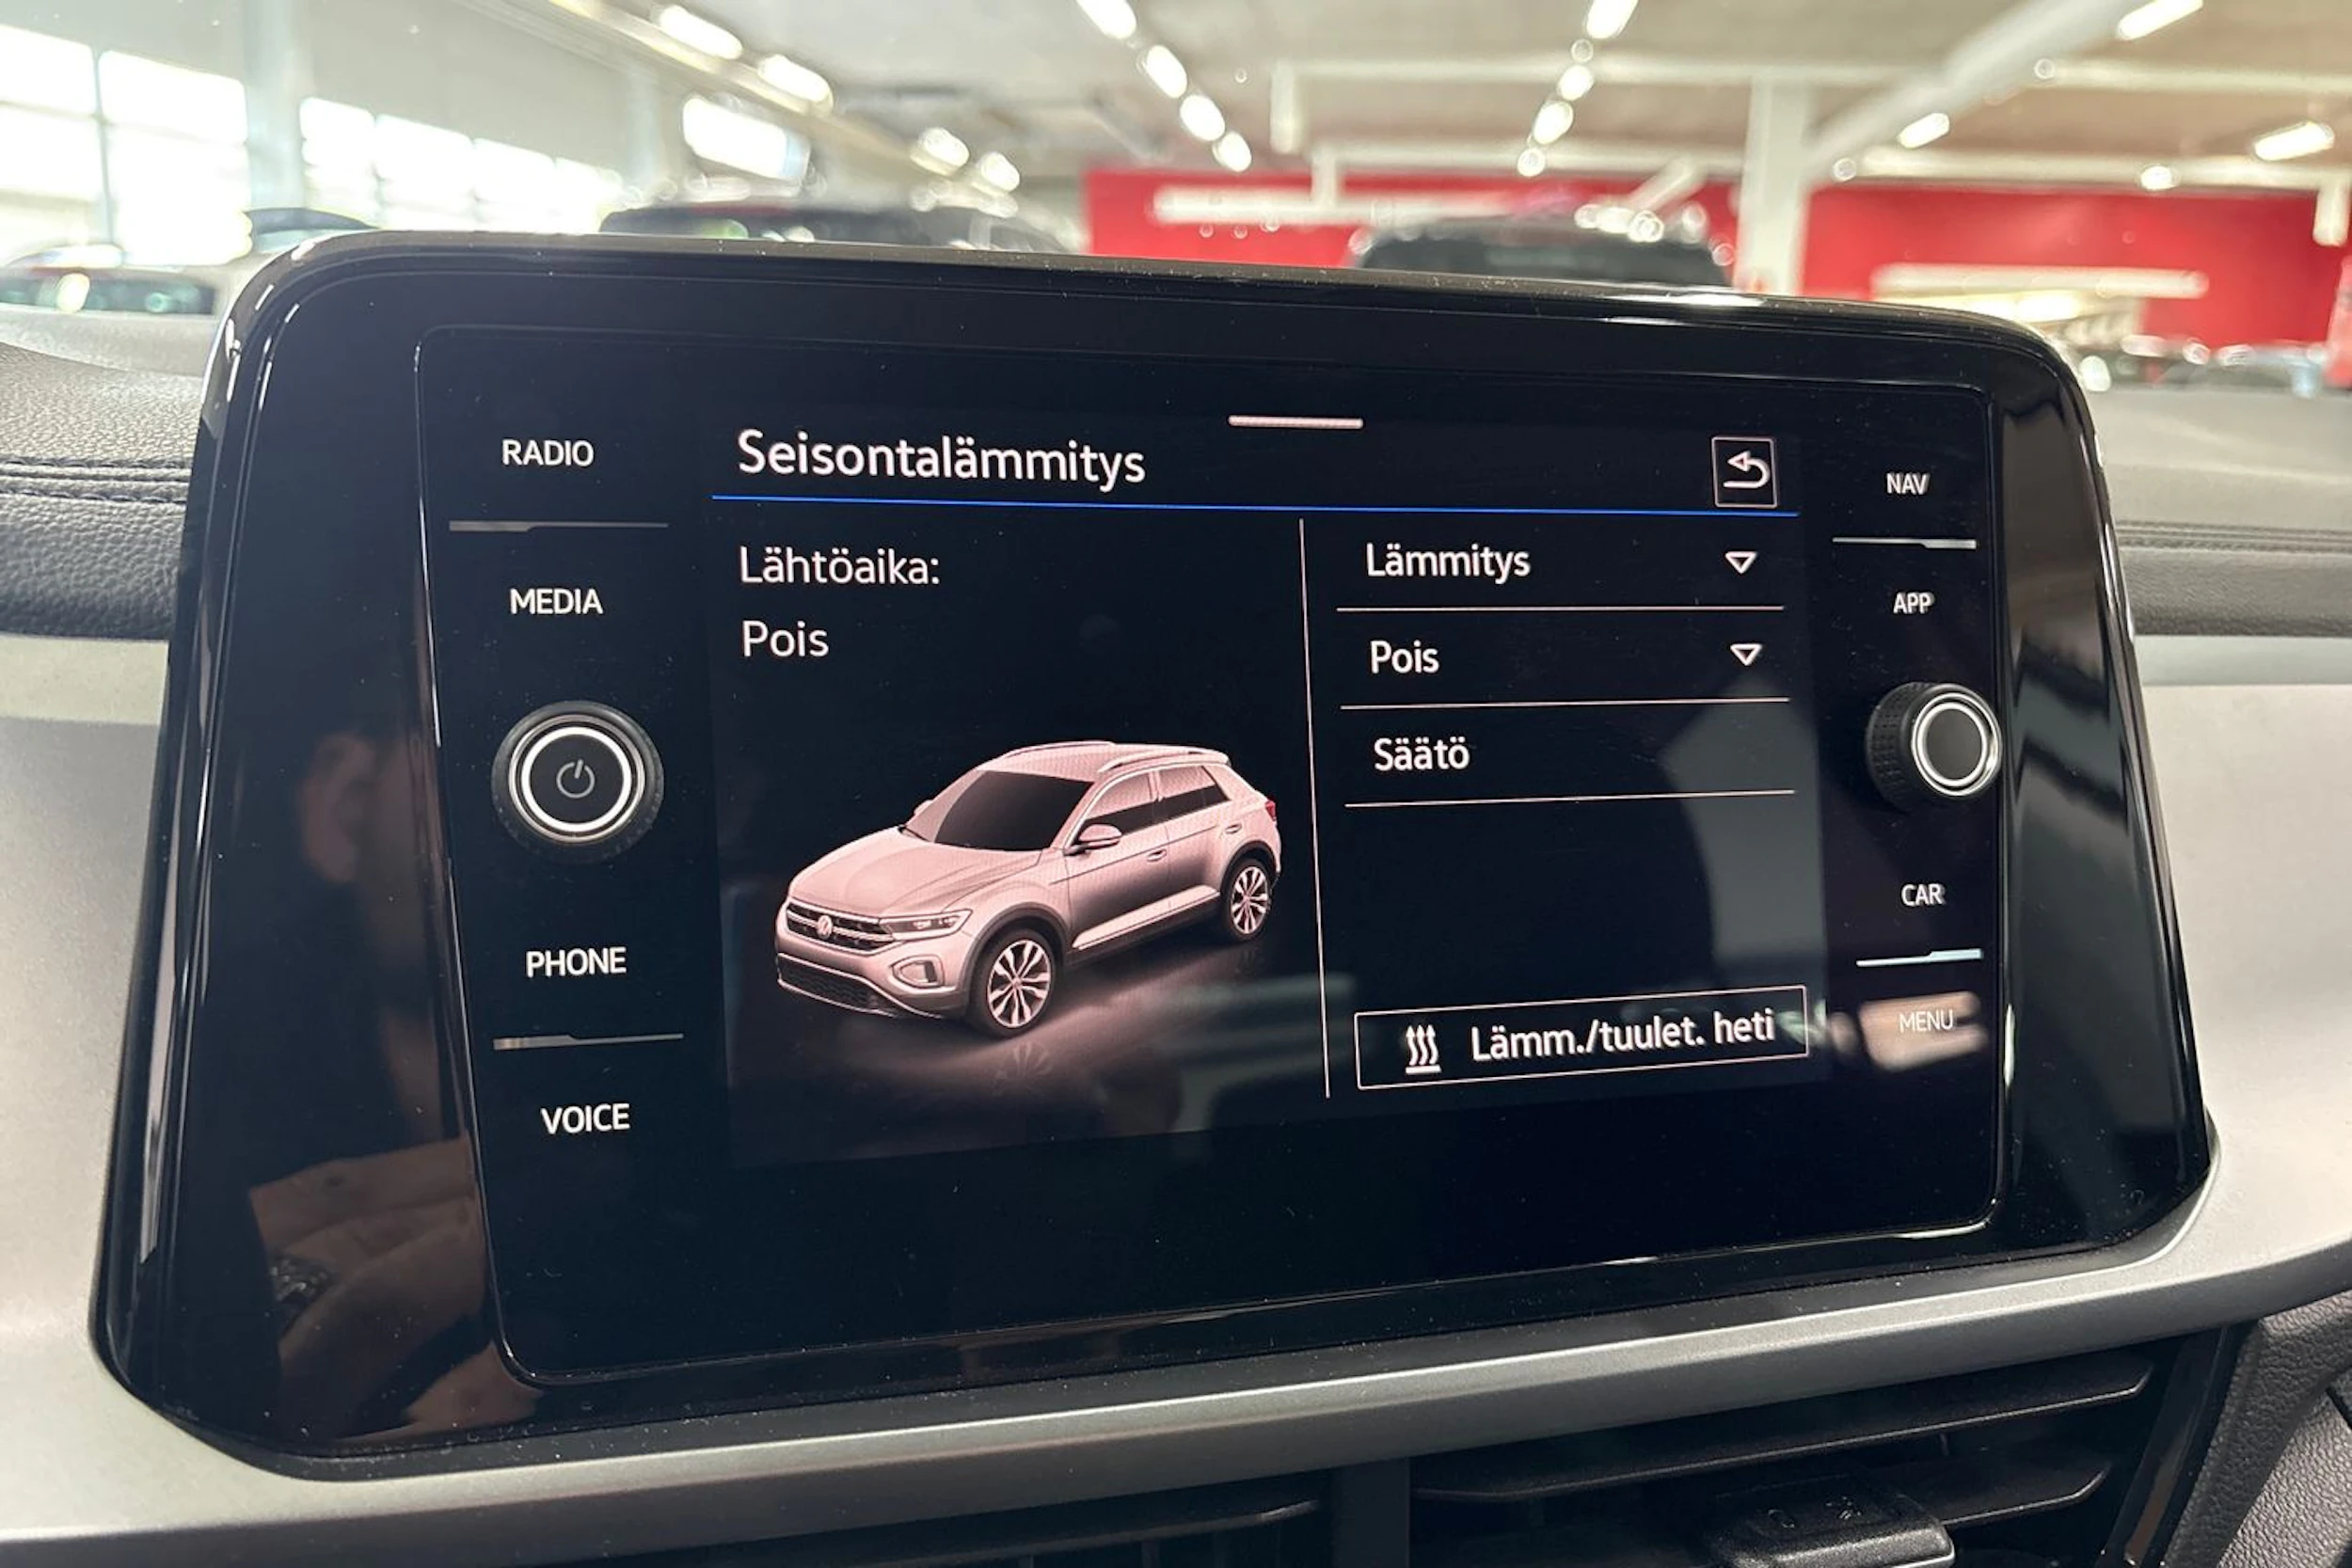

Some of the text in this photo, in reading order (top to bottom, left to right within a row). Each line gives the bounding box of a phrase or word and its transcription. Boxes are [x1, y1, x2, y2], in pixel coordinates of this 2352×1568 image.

[502, 438, 595, 467] RADIO
[738, 428, 1146, 492] Seisontalämmitys
[1886, 472, 1929, 495] NAV
[739, 546, 940, 585] Lähtöaika:
[1366, 543, 1531, 585] Lämmitys
[510, 588, 604, 615] MEDIA
[1893, 592, 1934, 614] APP
[742, 620, 829, 657] Pois
[1370, 640, 1439, 674] Pois
[1374, 736, 1470, 771] Säätö
[1900, 883, 1945, 907] CAR
[526, 946, 628, 978] PHONE
[1470, 1007, 1774, 1062] Lämm./tuulet. heti
[1899, 1008, 1953, 1033] MENU
[540, 1102, 630, 1135] VOICE
